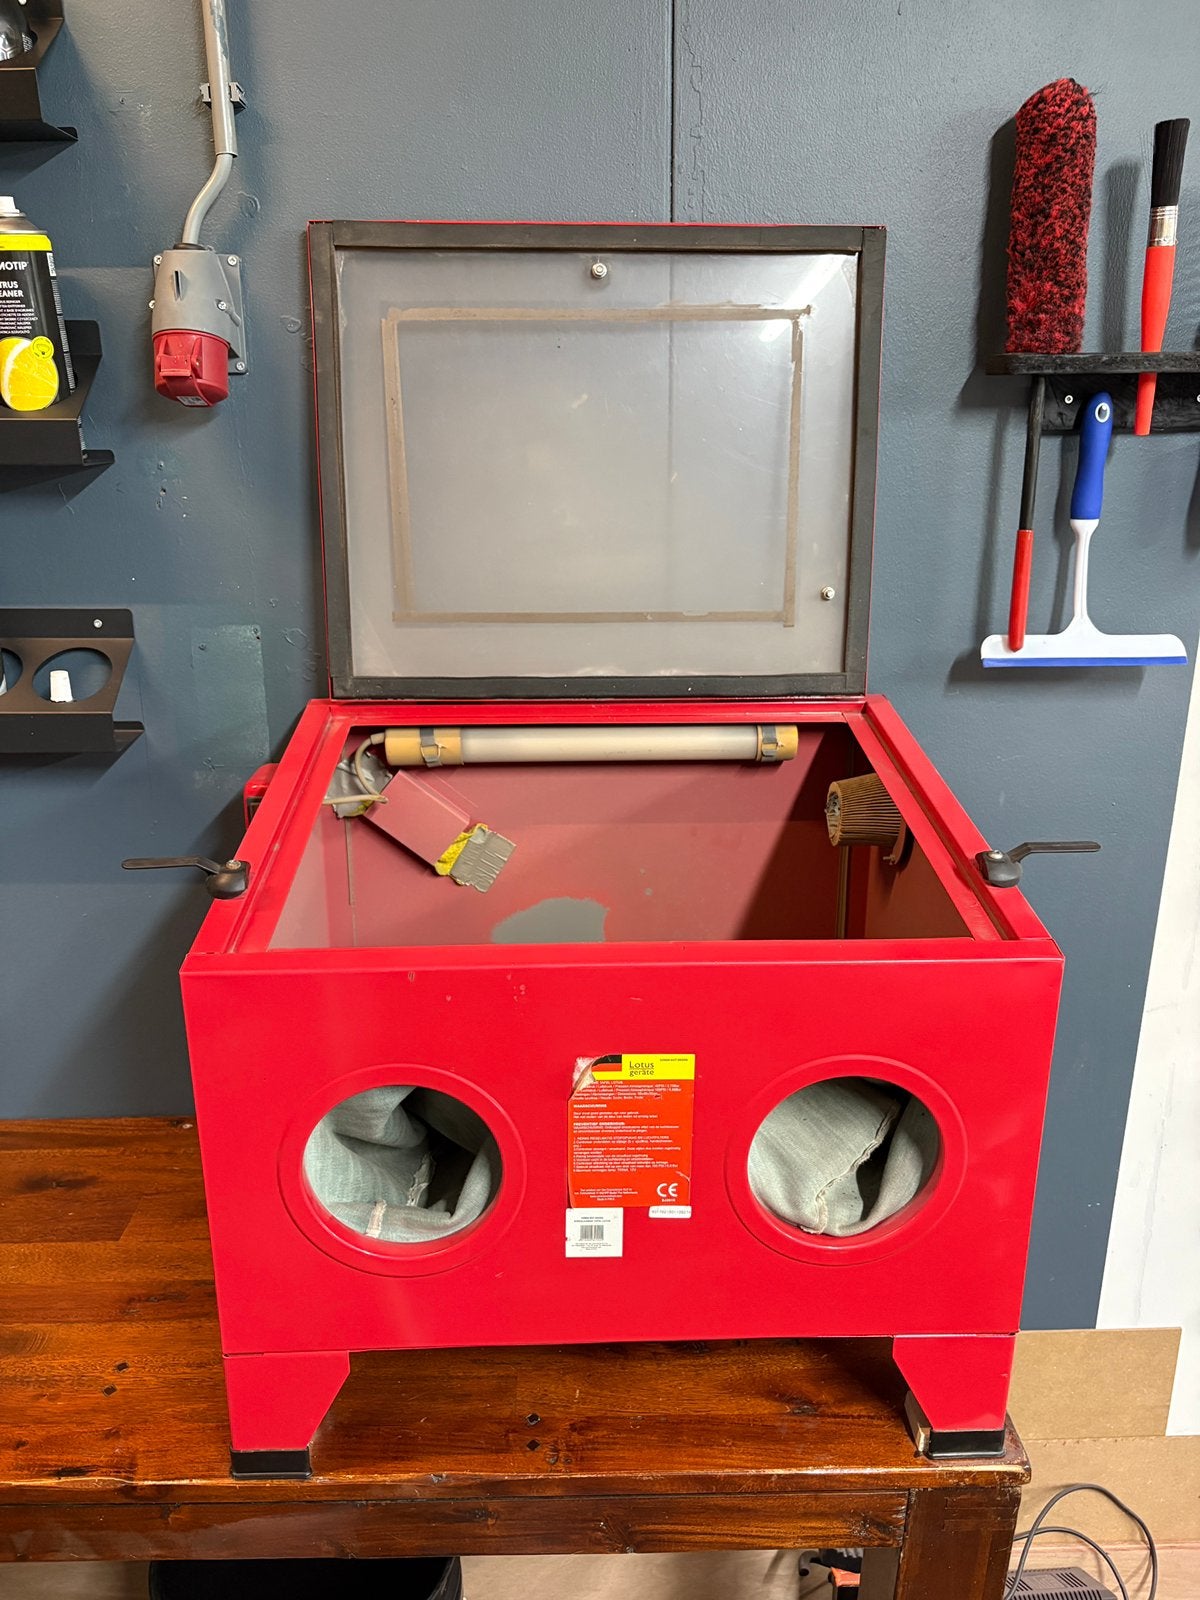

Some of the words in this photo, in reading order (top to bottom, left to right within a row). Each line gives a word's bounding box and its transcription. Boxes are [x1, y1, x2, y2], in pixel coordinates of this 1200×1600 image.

[0, 261, 28, 271] MOTIP
[629, 1060, 655, 1069] Lotus
[656, 1183, 679, 1198] CE
